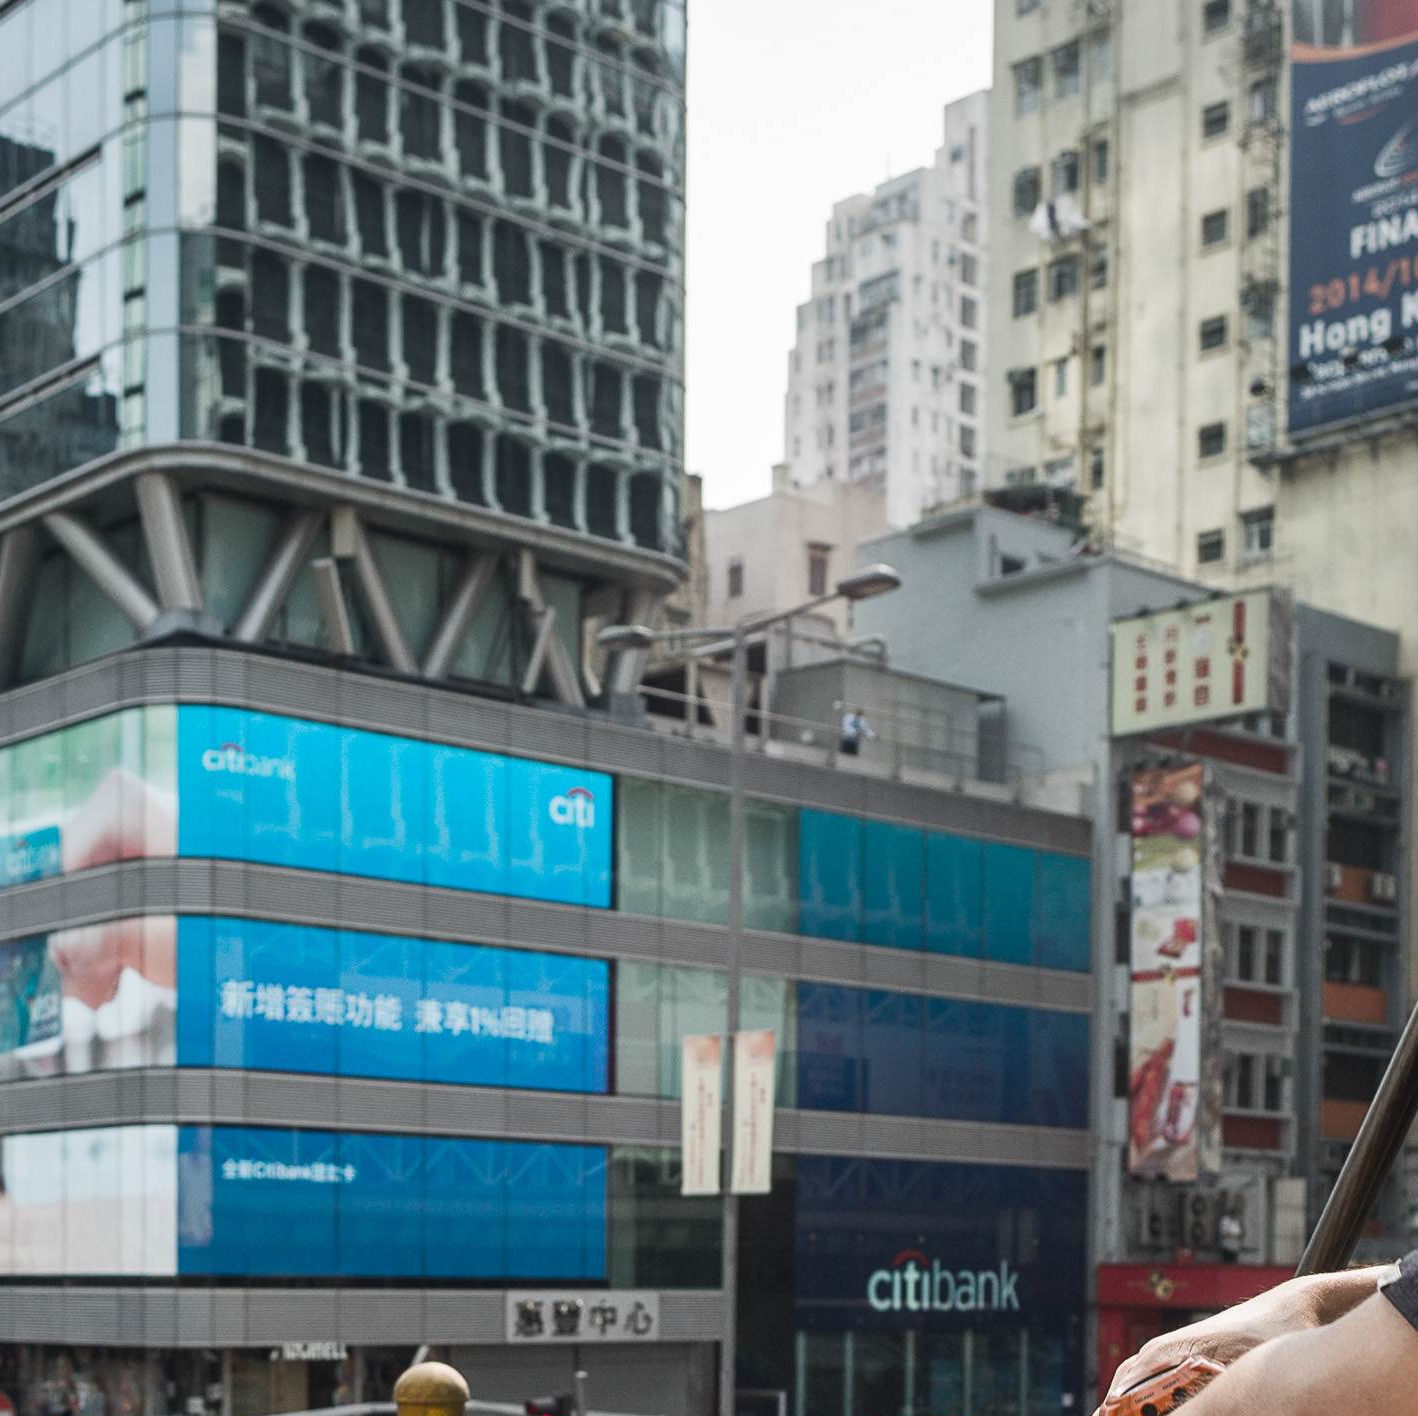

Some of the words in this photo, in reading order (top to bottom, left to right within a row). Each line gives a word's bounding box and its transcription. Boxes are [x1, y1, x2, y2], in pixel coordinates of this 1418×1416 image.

[1298, 306, 1393, 359] Hong
[548, 787, 595, 829] citi
[867, 1249, 1020, 1312] citibank
